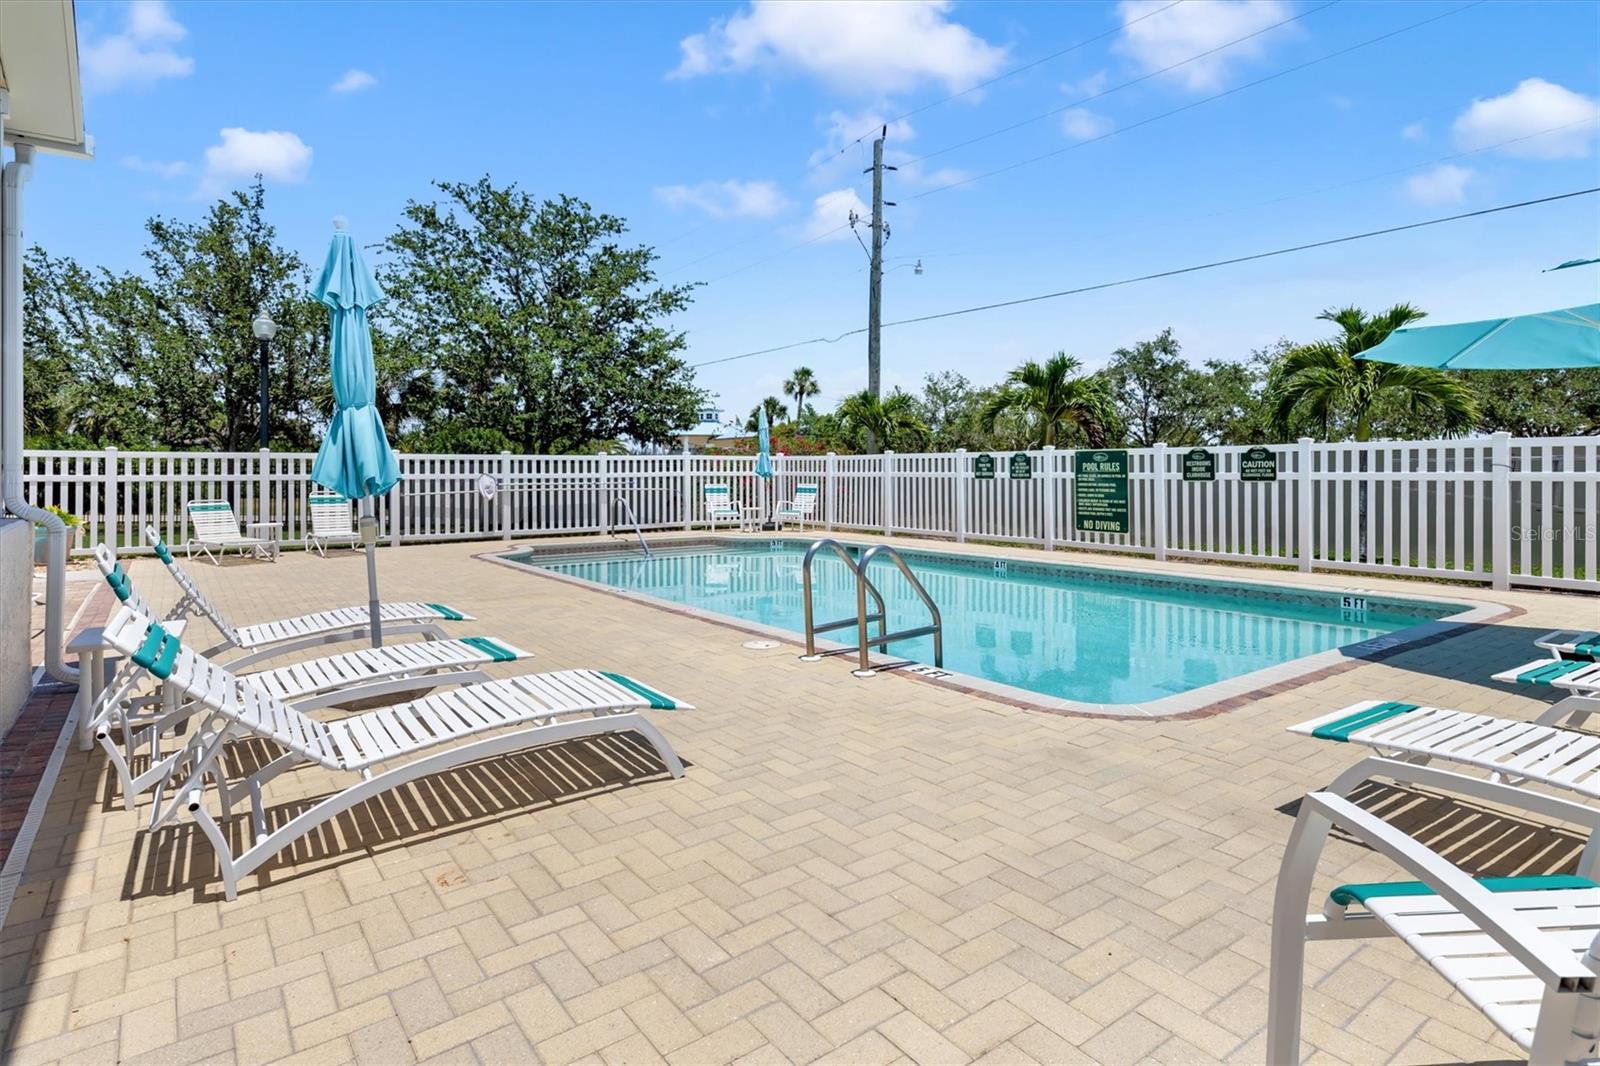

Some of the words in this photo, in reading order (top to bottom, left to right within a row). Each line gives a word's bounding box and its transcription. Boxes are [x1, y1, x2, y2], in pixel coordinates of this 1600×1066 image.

[1082, 462, 1099, 471] POOL
[1099, 462, 1120, 471] RULES
[1242, 460, 1275, 468] CAUTION
[1083, 520, 1094, 529] NO
[1095, 520, 1120, 531] DIVING
[1343, 596, 1351, 608] 5
[1354, 598, 1365, 609] FT
